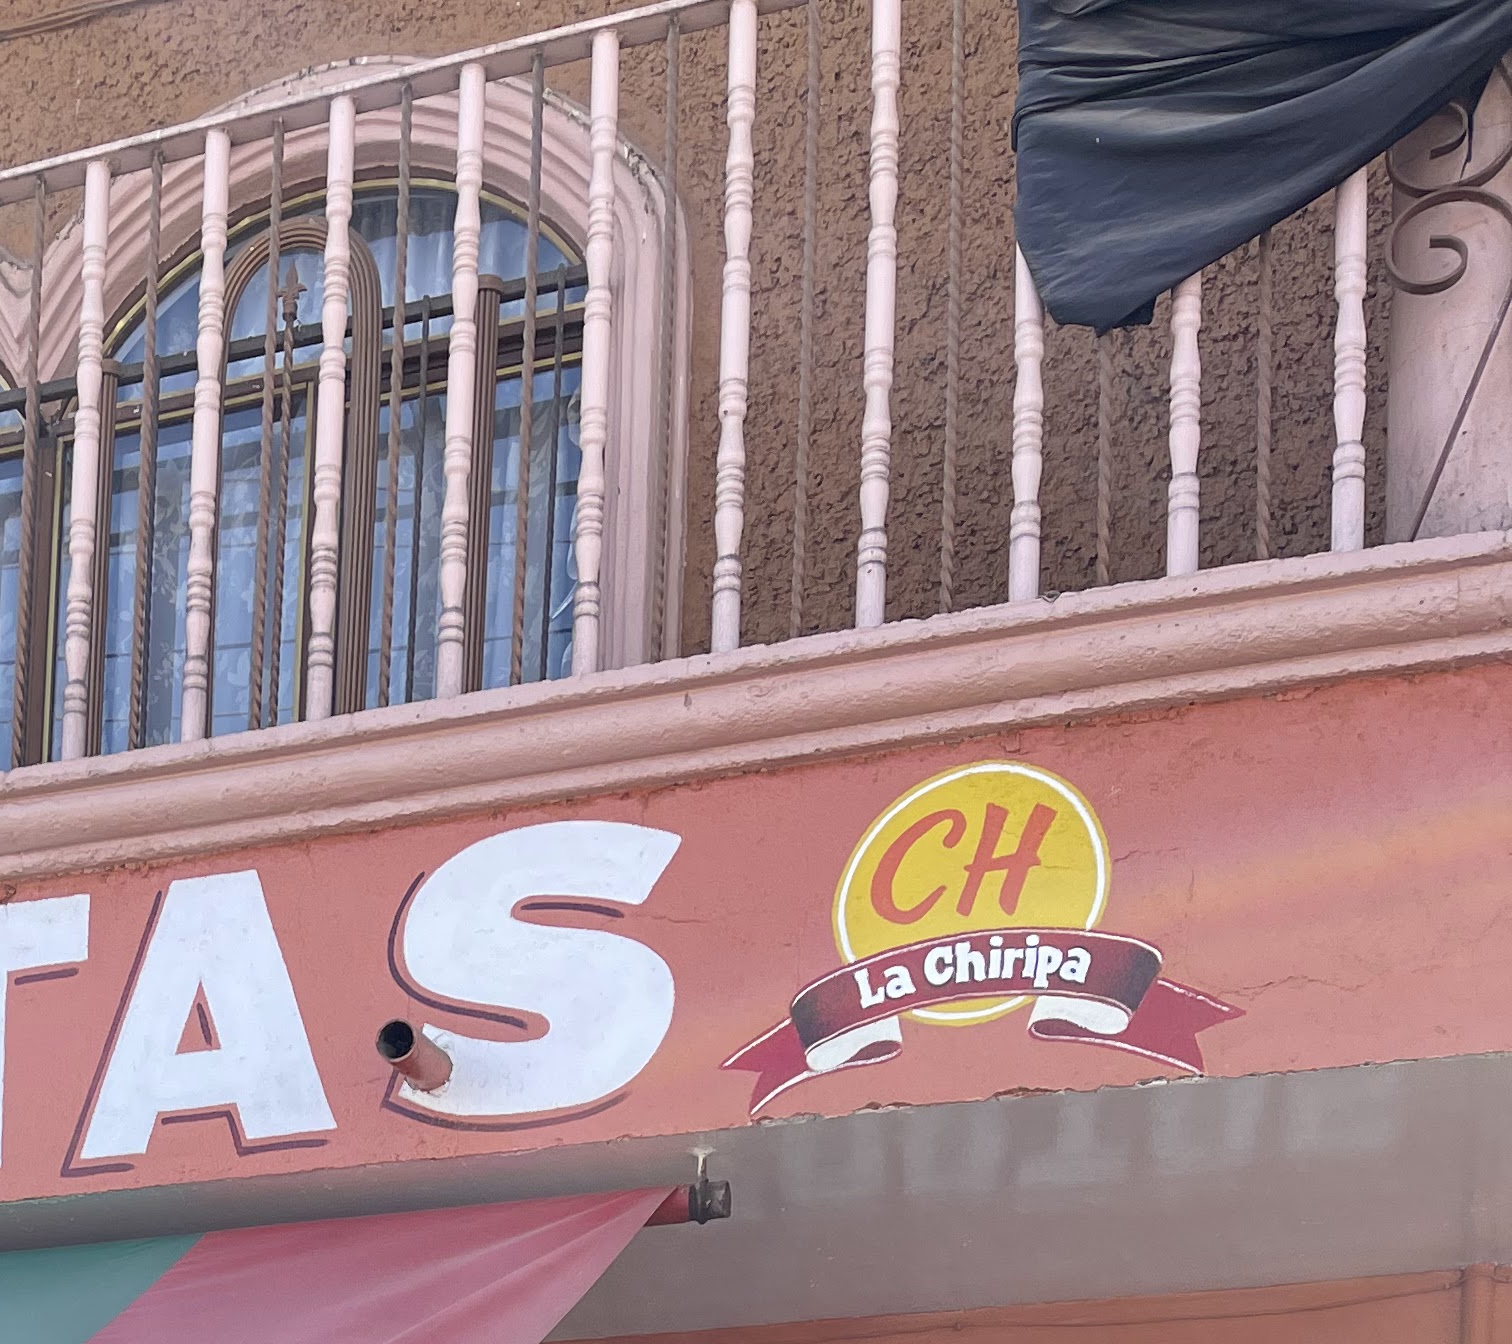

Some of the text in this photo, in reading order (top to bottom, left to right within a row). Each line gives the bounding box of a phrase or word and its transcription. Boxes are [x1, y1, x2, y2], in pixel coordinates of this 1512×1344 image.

[870, 802, 1058, 924] CH
[853, 934, 1092, 1009] La Chiripa
